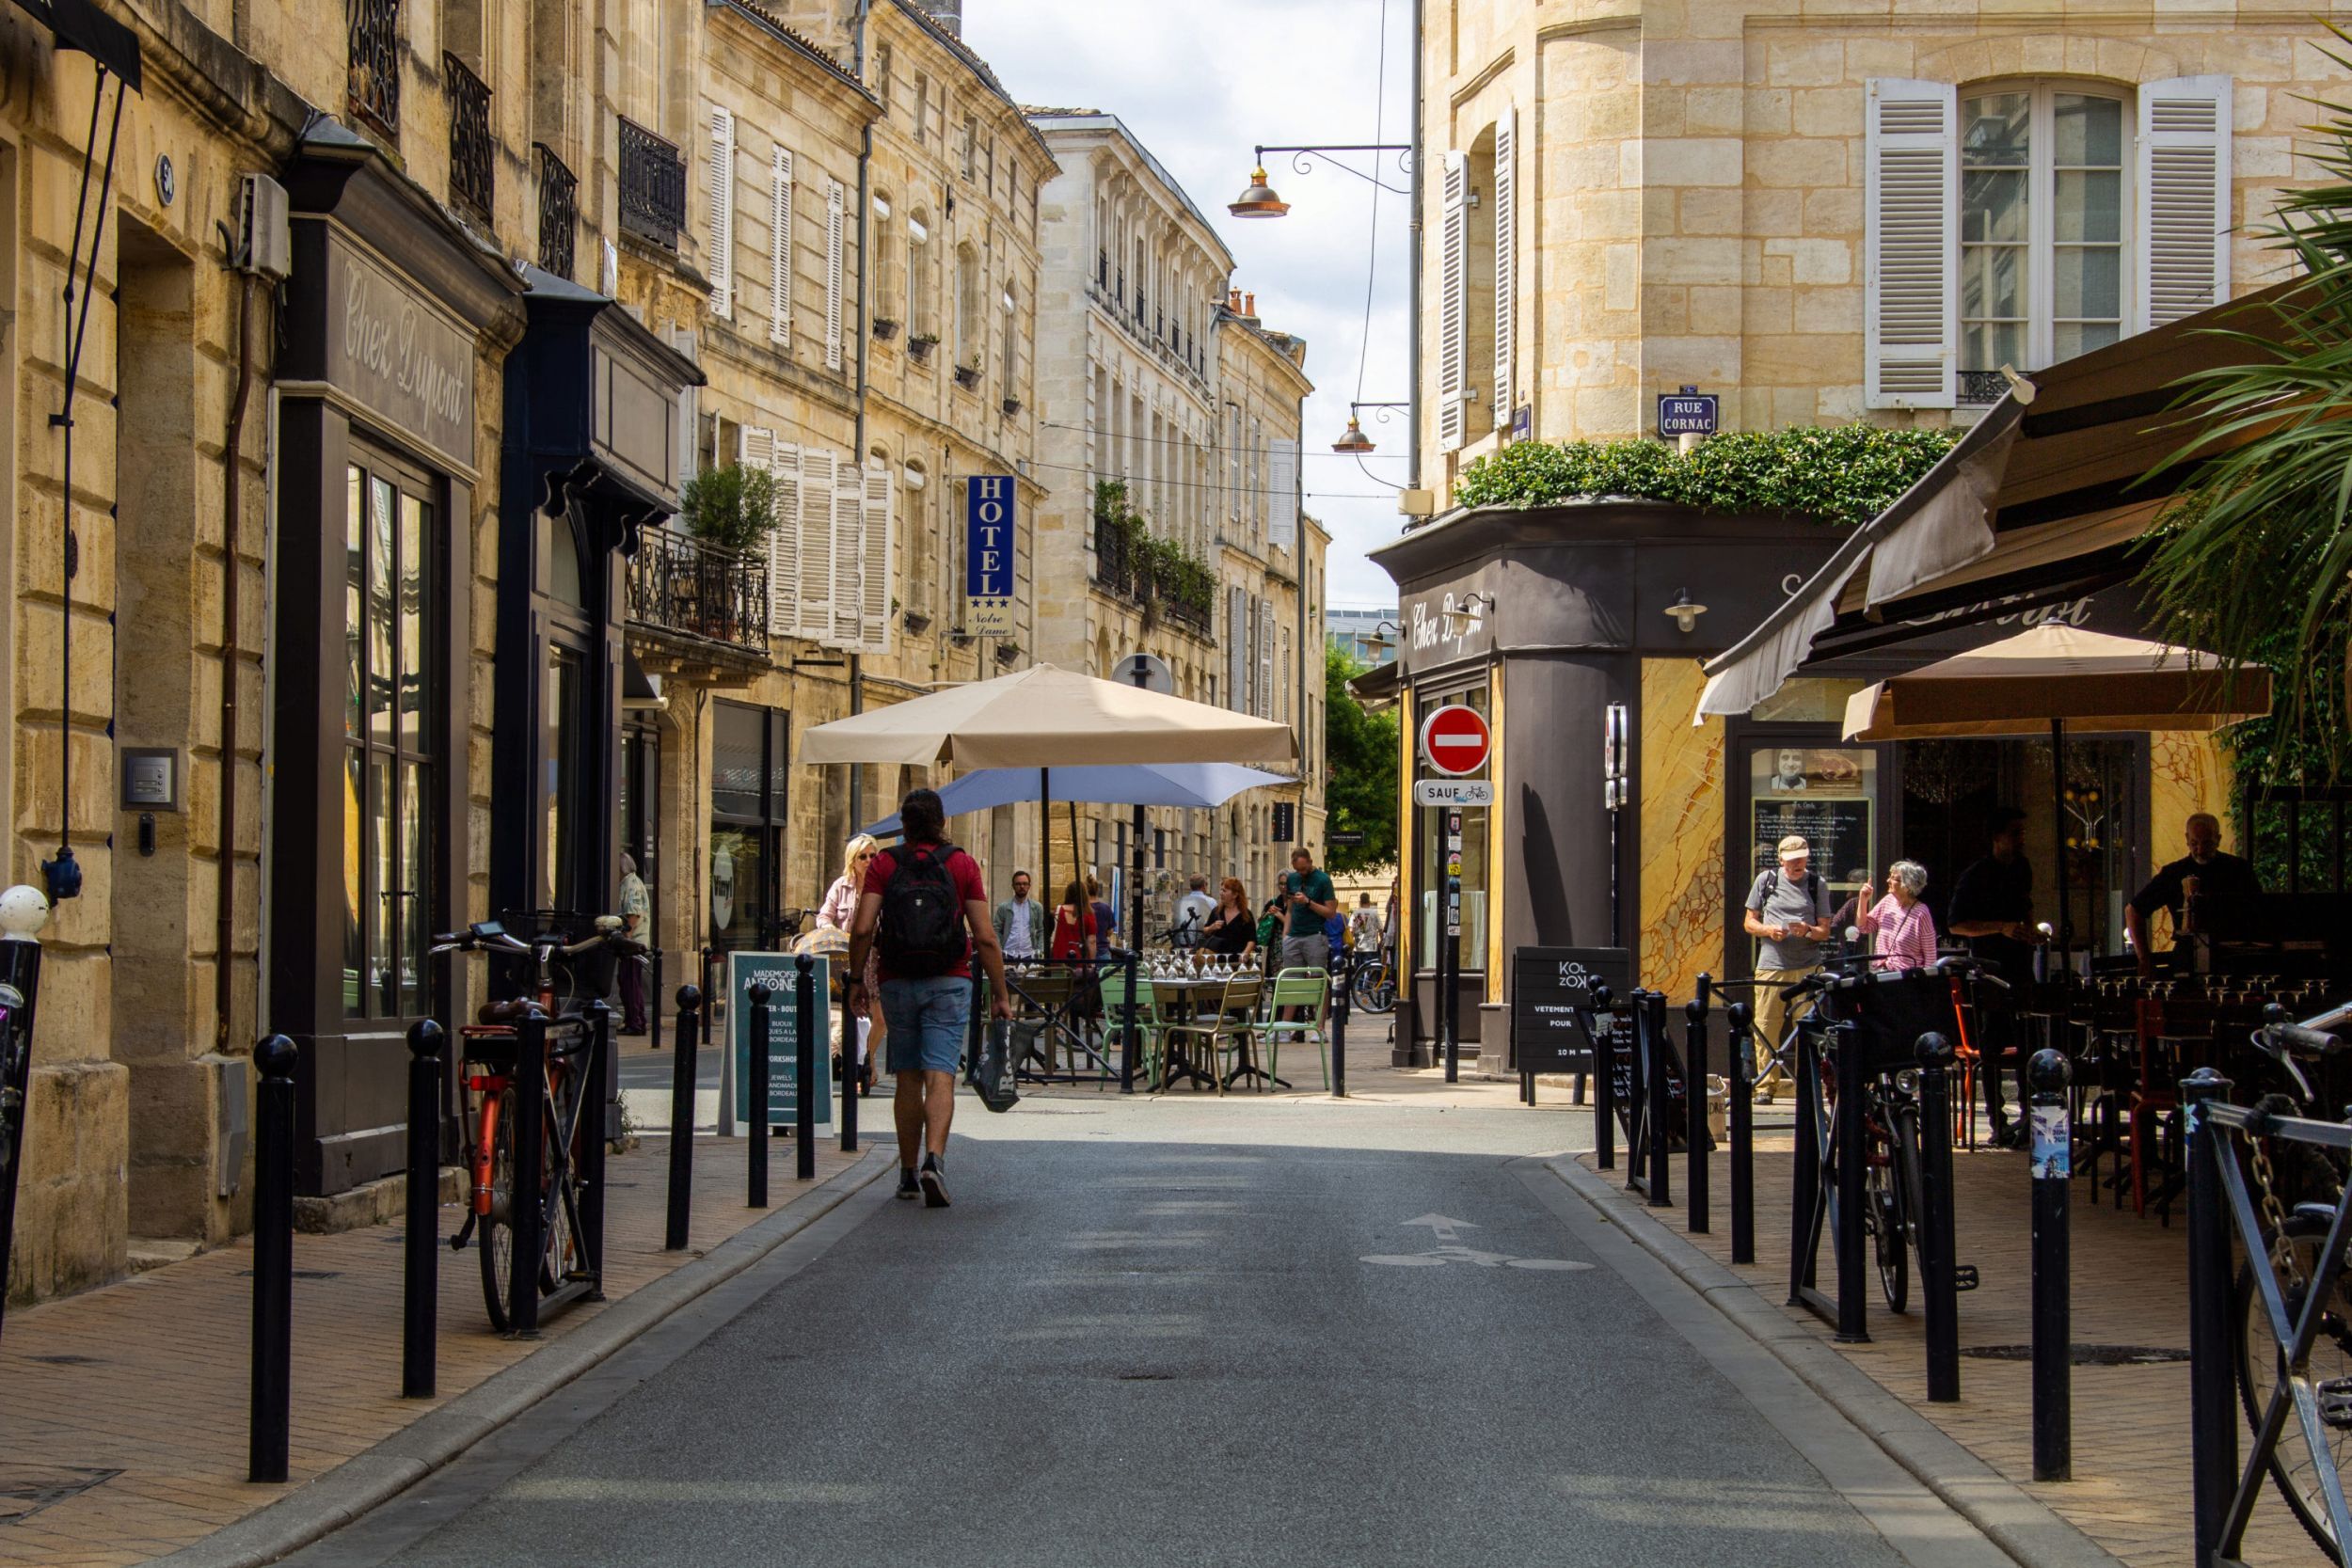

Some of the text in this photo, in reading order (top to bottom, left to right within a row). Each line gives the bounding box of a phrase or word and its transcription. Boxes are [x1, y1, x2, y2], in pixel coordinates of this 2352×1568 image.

[343, 260, 465, 433] Chez Dupont
[1674, 402, 1702, 414] RUE
[1664, 418, 1711, 430] CORNAC
[978, 477, 1003, 595] HOTEL
[968, 611, 1003, 625] Notre
[976, 625, 1009, 636] Dame
[1413, 601, 1438, 651] Chez
[1428, 787, 1459, 799] SAUF
[713, 875, 733, 900] Vinyl
[754, 970, 814, 979] MADEMOISE
[1559, 961, 1587, 975] KOL
